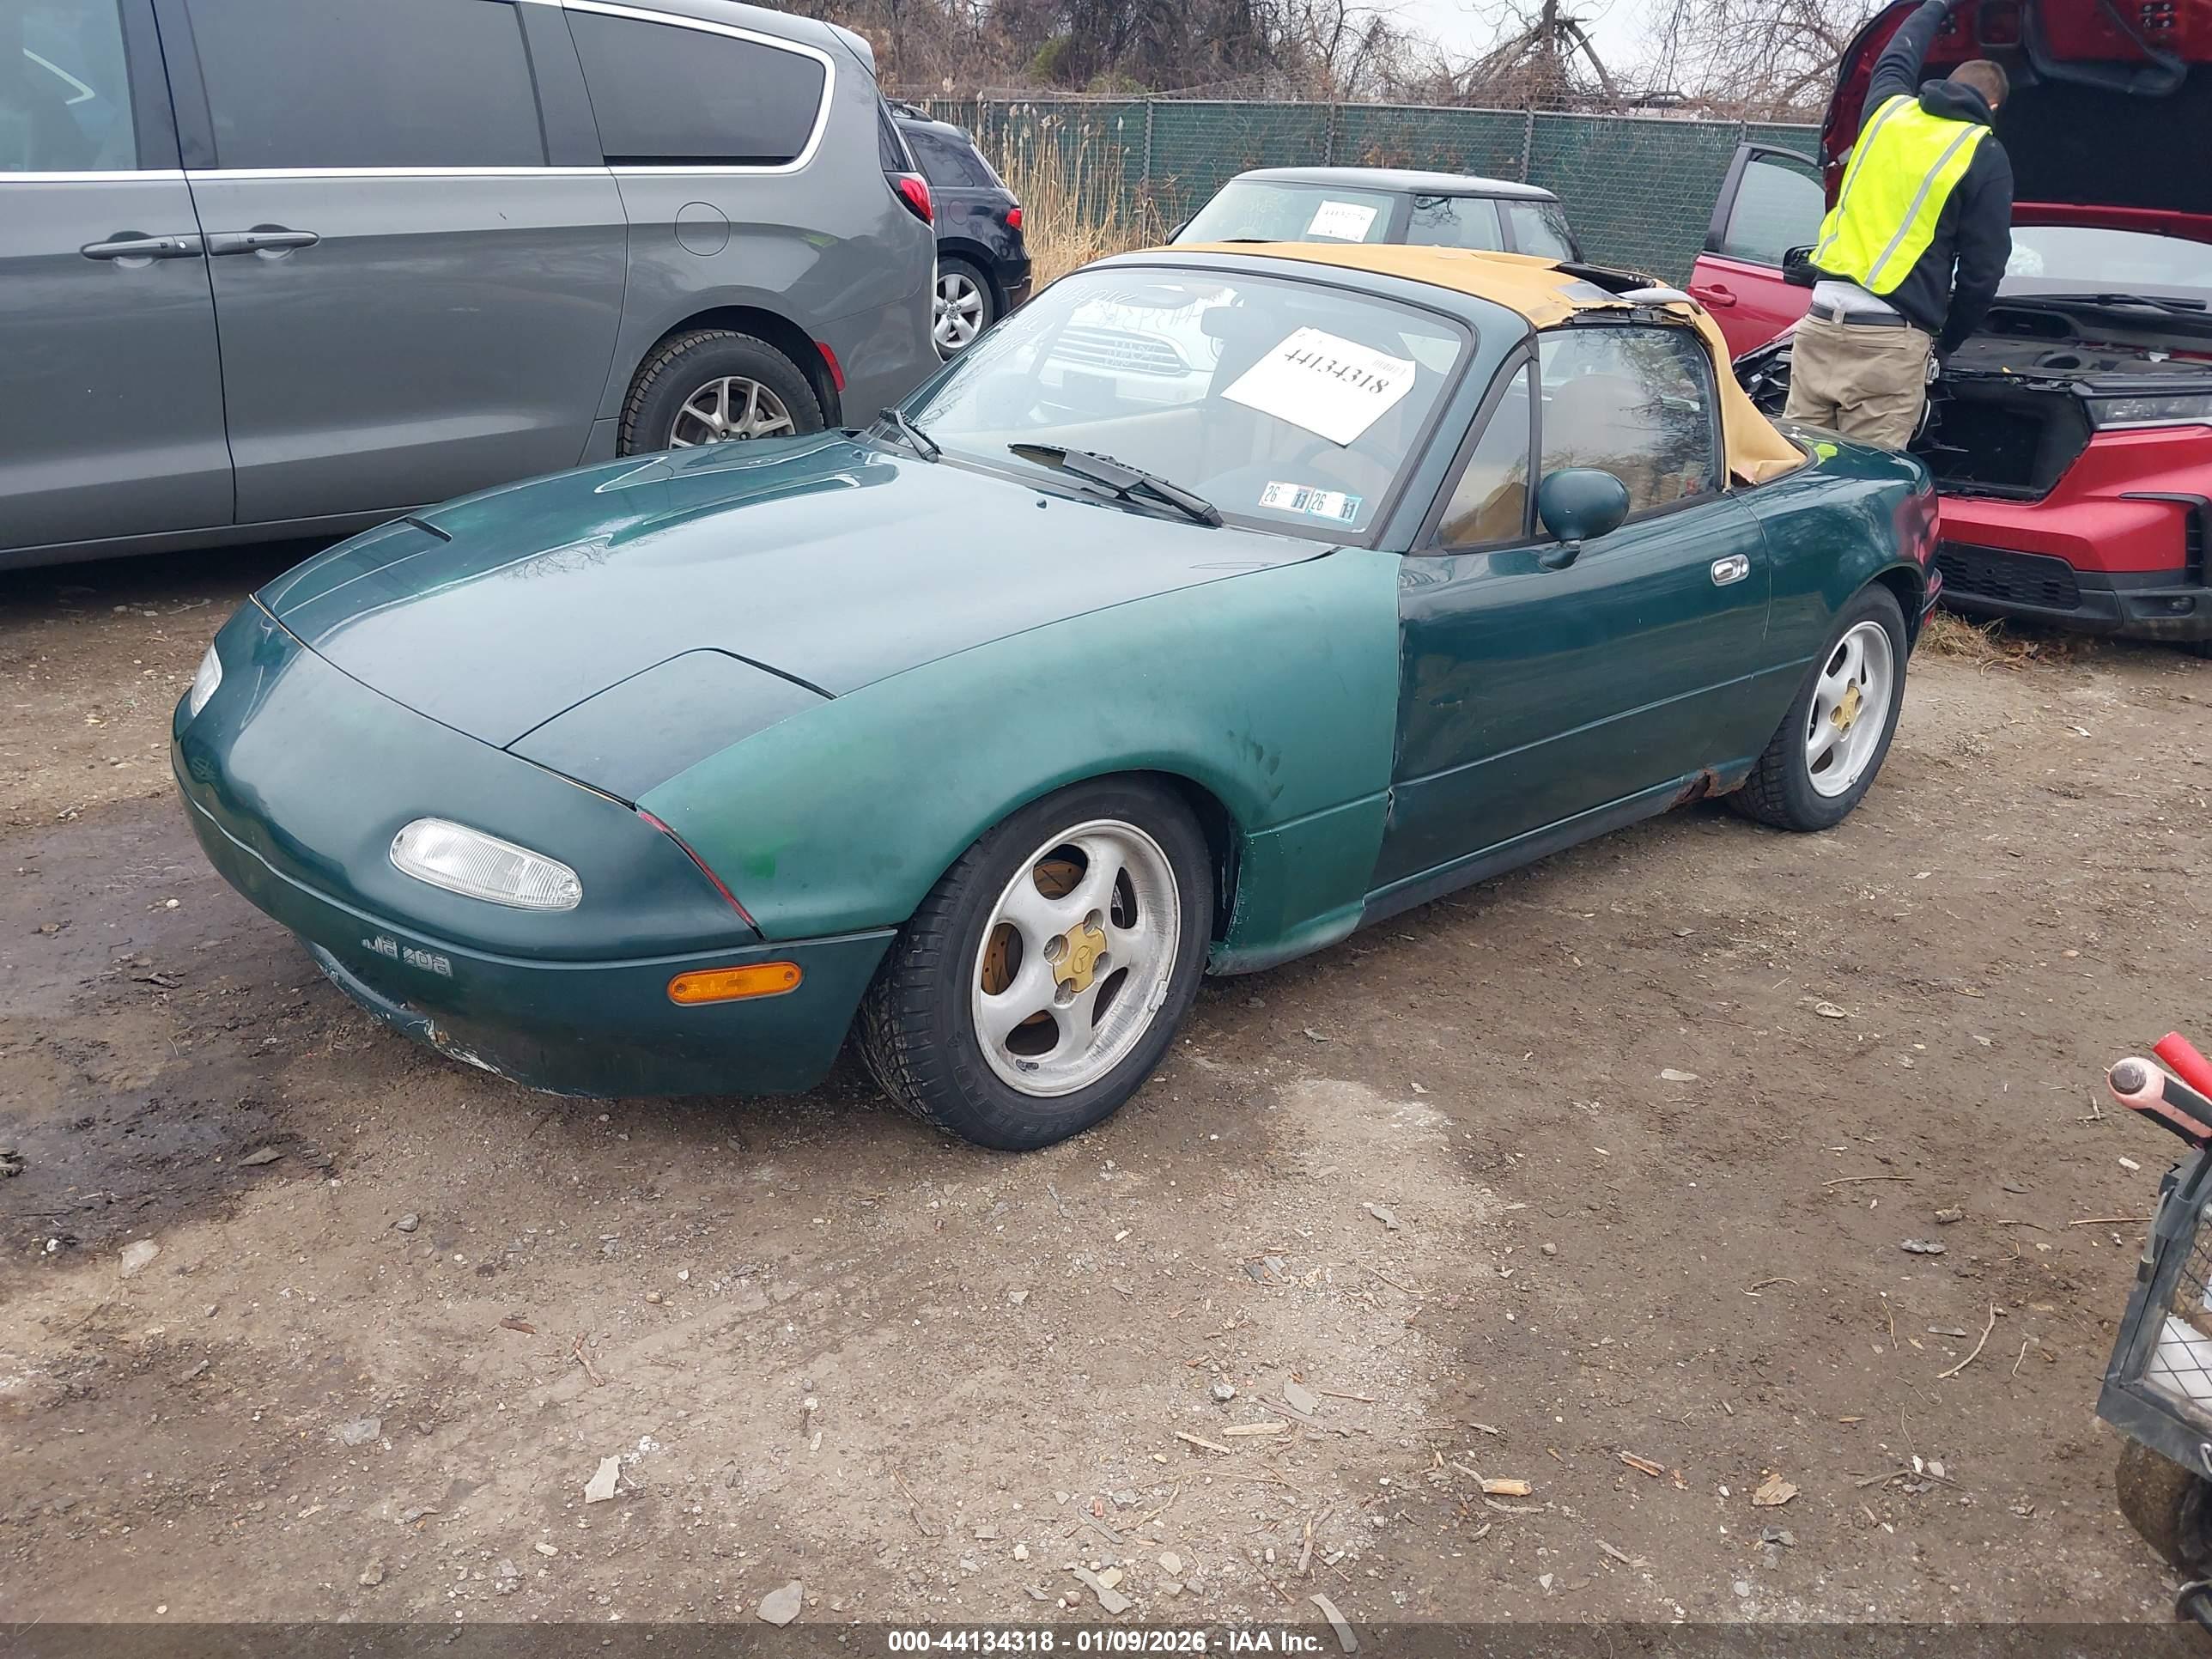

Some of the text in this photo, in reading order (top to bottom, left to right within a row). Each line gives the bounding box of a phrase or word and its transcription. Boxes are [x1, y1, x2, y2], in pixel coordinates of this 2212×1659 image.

[1284, 349, 1390, 394] 44134318
[1264, 485, 1309, 509] 26 11
[1310, 493, 1356, 520] 26 11
